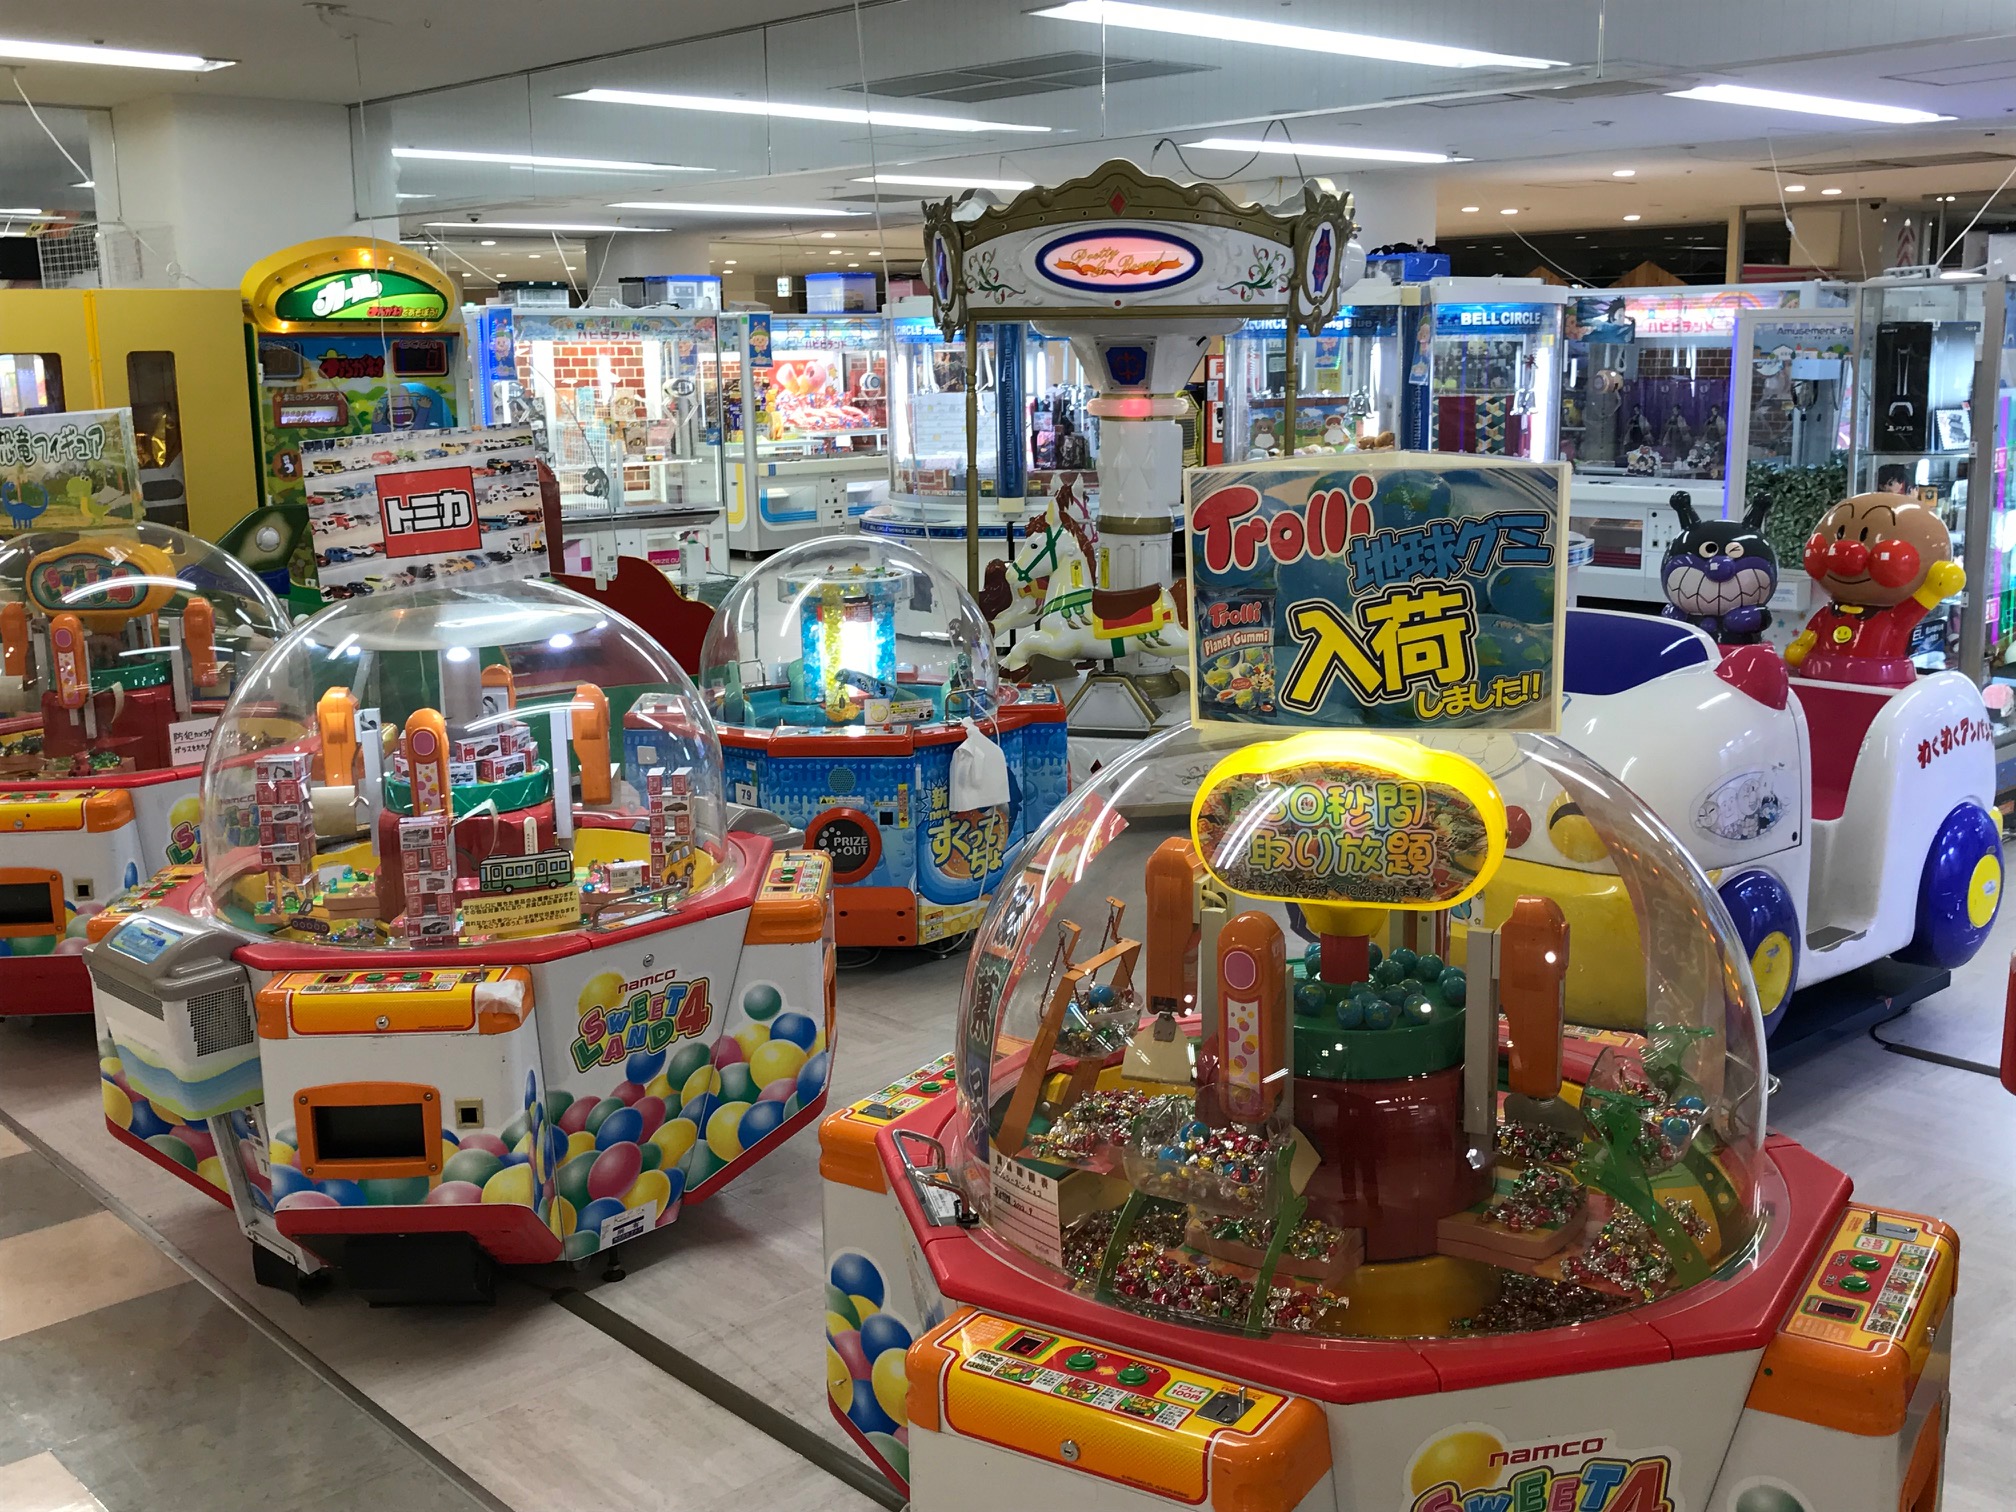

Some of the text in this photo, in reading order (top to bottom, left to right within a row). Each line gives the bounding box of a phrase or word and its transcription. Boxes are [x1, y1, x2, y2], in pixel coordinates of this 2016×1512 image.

[312, 273, 383, 317] カール
[1460, 311, 1541, 326] BELL CIRCLE
[1777, 327, 1836, 336] Amusement
[384, 489, 473, 535] トミカ
[1192, 475, 1375, 571] Trolli
[1350, 512, 1554, 592] 地球グミ
[1208, 601, 1262, 629] Trolli
[1204, 630, 1269, 657] Planet Gummi
[1289, 588, 1468, 704] 入荷
[1416, 672, 1543, 719] しました!!
[740, 788, 752, 801] 79
[931, 787, 948, 810] 新
[1254, 781, 1426, 830] 30秒間
[833, 836, 869, 847] PRIZE
[842, 845, 869, 857] OUT
[1249, 829, 1436, 877] 取り放題
[617, 969, 677, 994] namco
[581, 980, 710, 1046] SWEET 4
[573, 1016, 675, 1070] LAND
[1171, 1389, 1203, 1402] 100円
[1488, 1437, 1607, 1468] namco
